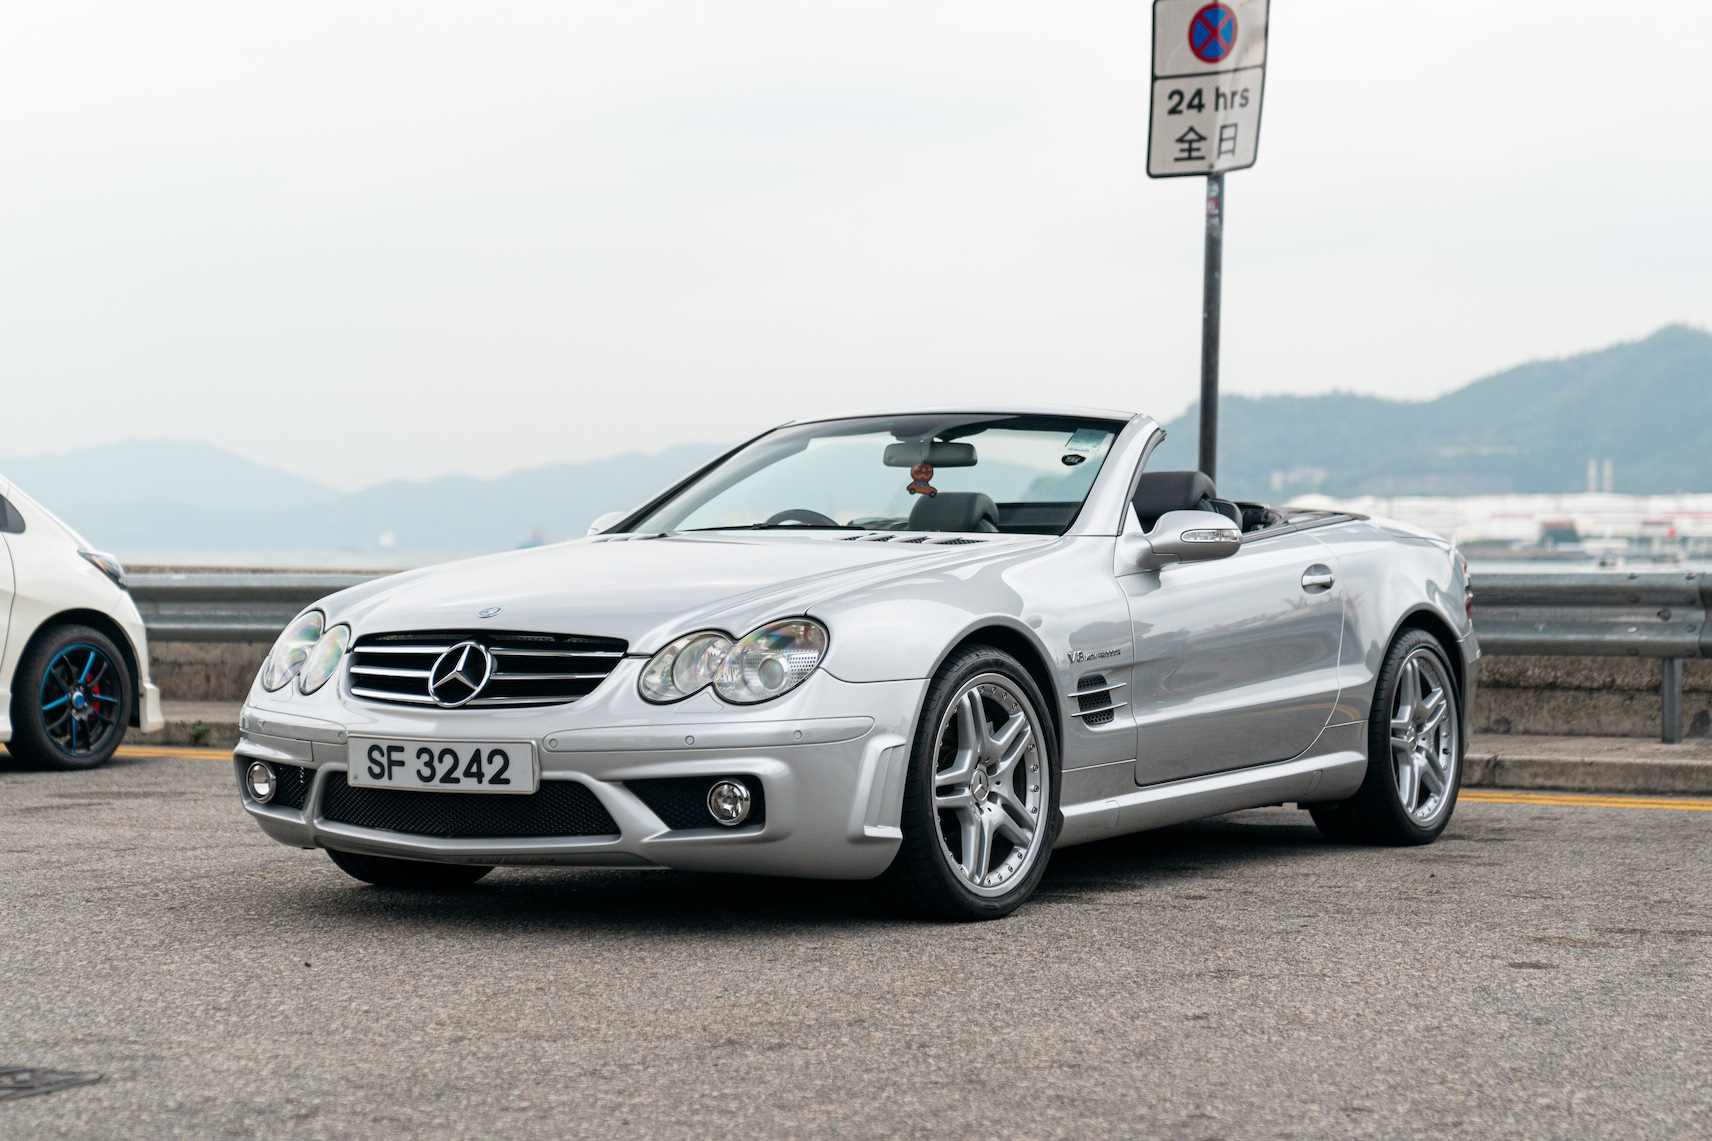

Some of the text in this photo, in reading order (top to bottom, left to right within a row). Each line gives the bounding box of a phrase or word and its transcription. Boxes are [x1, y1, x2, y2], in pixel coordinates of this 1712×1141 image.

[1167, 86, 1249, 115] 24 hrs
[1173, 123, 1238, 162] 全日
[1067, 650, 1084, 664] V8
[367, 744, 511, 785] SF 3242
